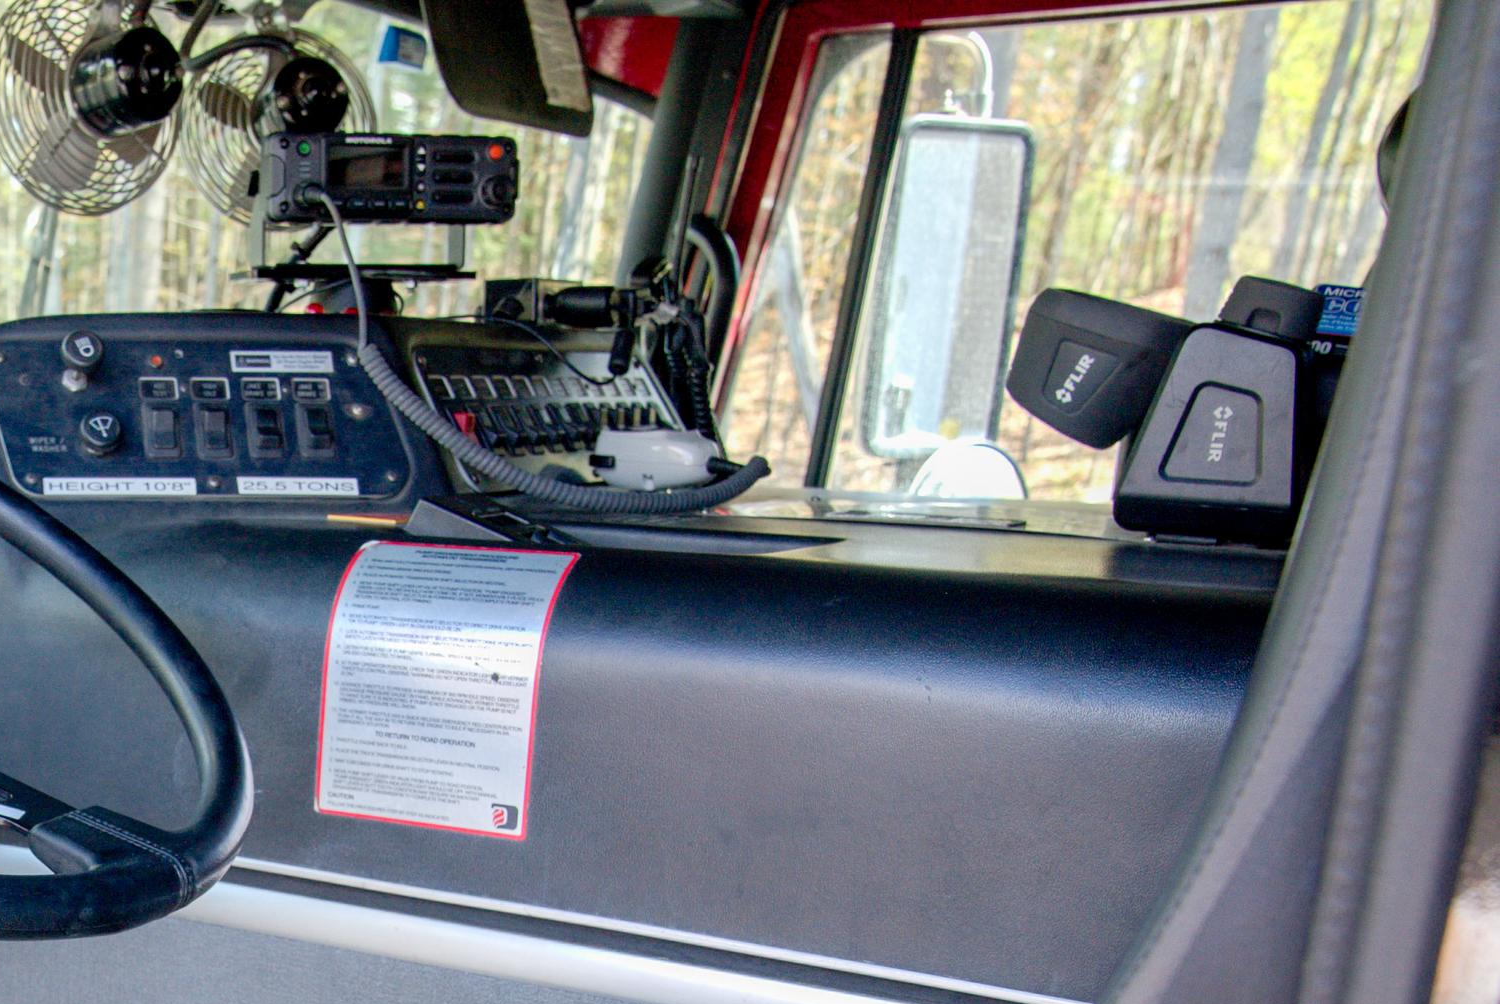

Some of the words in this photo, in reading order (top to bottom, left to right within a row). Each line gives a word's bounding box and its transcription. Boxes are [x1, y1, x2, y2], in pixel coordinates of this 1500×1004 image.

[1064, 353, 1095, 393] FLIR
[1206, 421, 1228, 463] FLIR
[48, 481, 134, 492] HEIGHT
[144, 481, 192, 492] 10'8"
[242, 481, 287, 491] 25.5
[293, 481, 355, 492] TONS
[375, 730, 384, 738] TO
[385, 732, 410, 740] RETURN
[420, 736, 439, 744] ROAD
[440, 737, 476, 748] OPERATION
